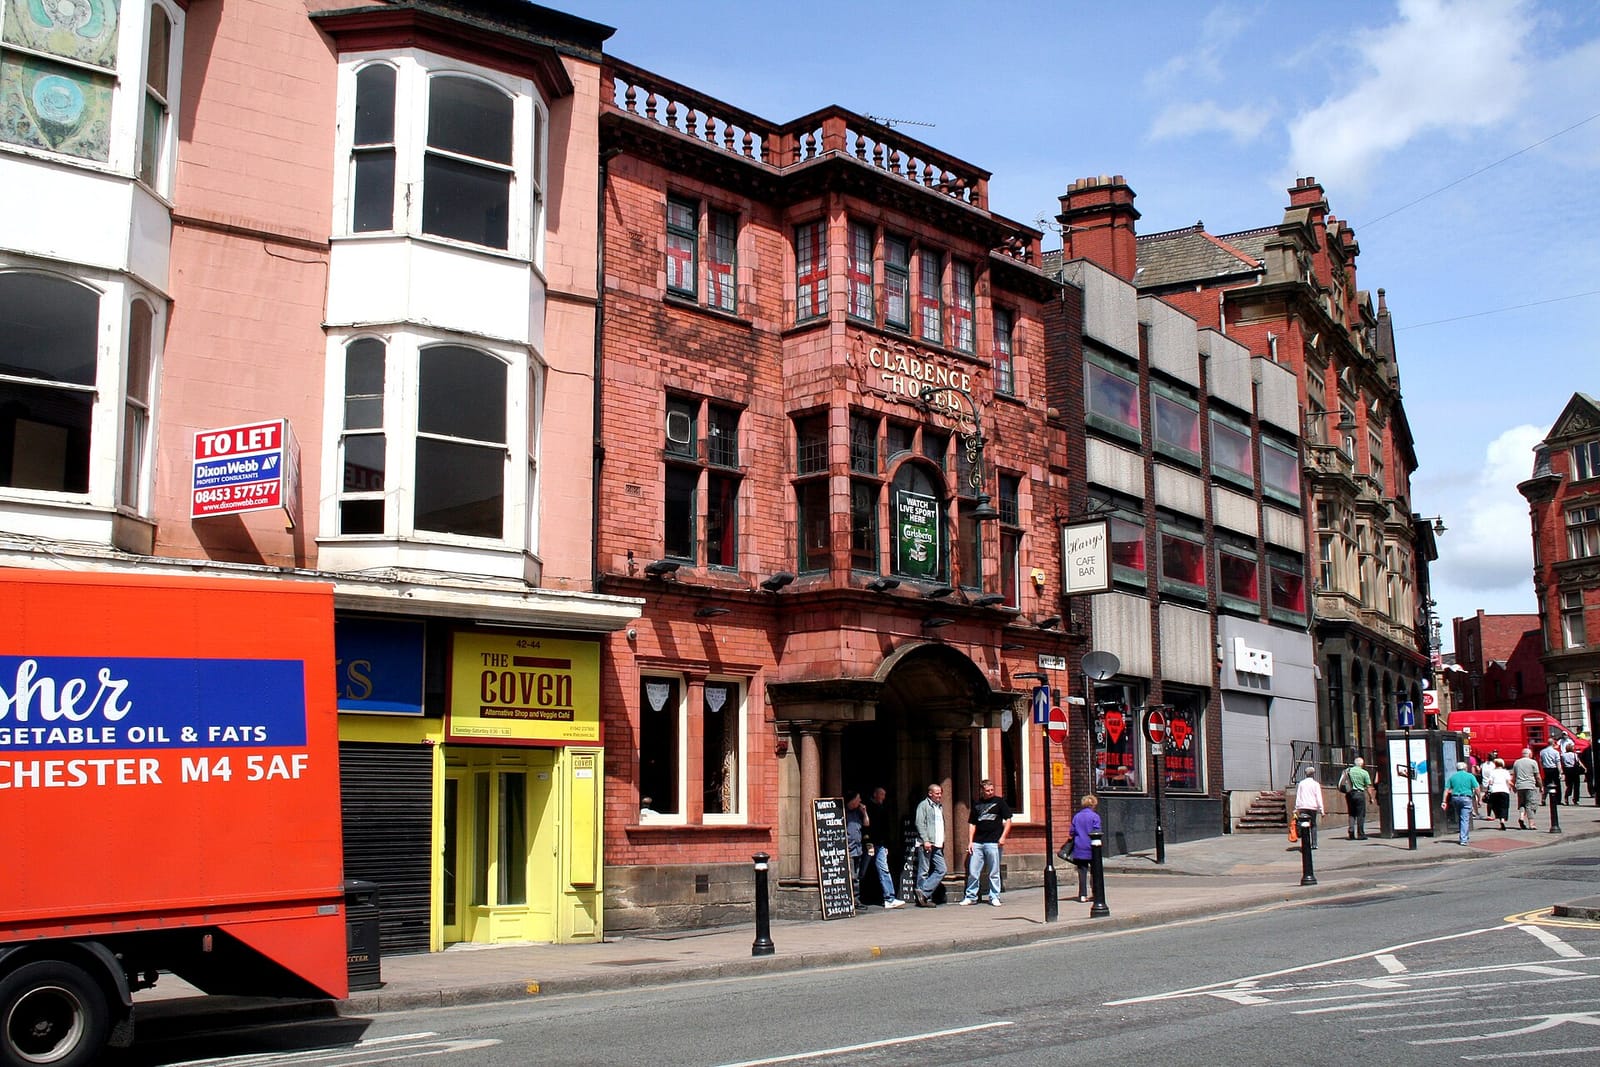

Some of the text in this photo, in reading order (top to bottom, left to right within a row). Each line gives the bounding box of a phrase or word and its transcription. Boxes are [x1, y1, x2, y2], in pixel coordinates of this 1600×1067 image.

[869, 347, 972, 393] CLARENCE
[201, 426, 277, 456] TO LET
[197, 459, 259, 479] Dixon Webb
[195, 481, 278, 504] 08453 577577
[899, 504, 936, 518] LIVE SPORT
[906, 497, 929, 510] WATCH
[909, 513, 926, 524] HERE
[903, 524, 932, 543] Carlsberg
[1076, 556, 1096, 566] CAFE
[1078, 566, 1096, 577] BAR
[516, 639, 541, 649] 42-44
[480, 652, 509, 667] THE
[485, 708, 514, 717] Alternative
[514, 709, 528, 718] Shop
[540, 711, 557, 719] Veggie
[127, 726, 170, 743] OIL
[180, 726, 199, 742] &
[208, 725, 268, 742] FATS
[181, 756, 232, 783] M4
[246, 754, 310, 781] 5AF
